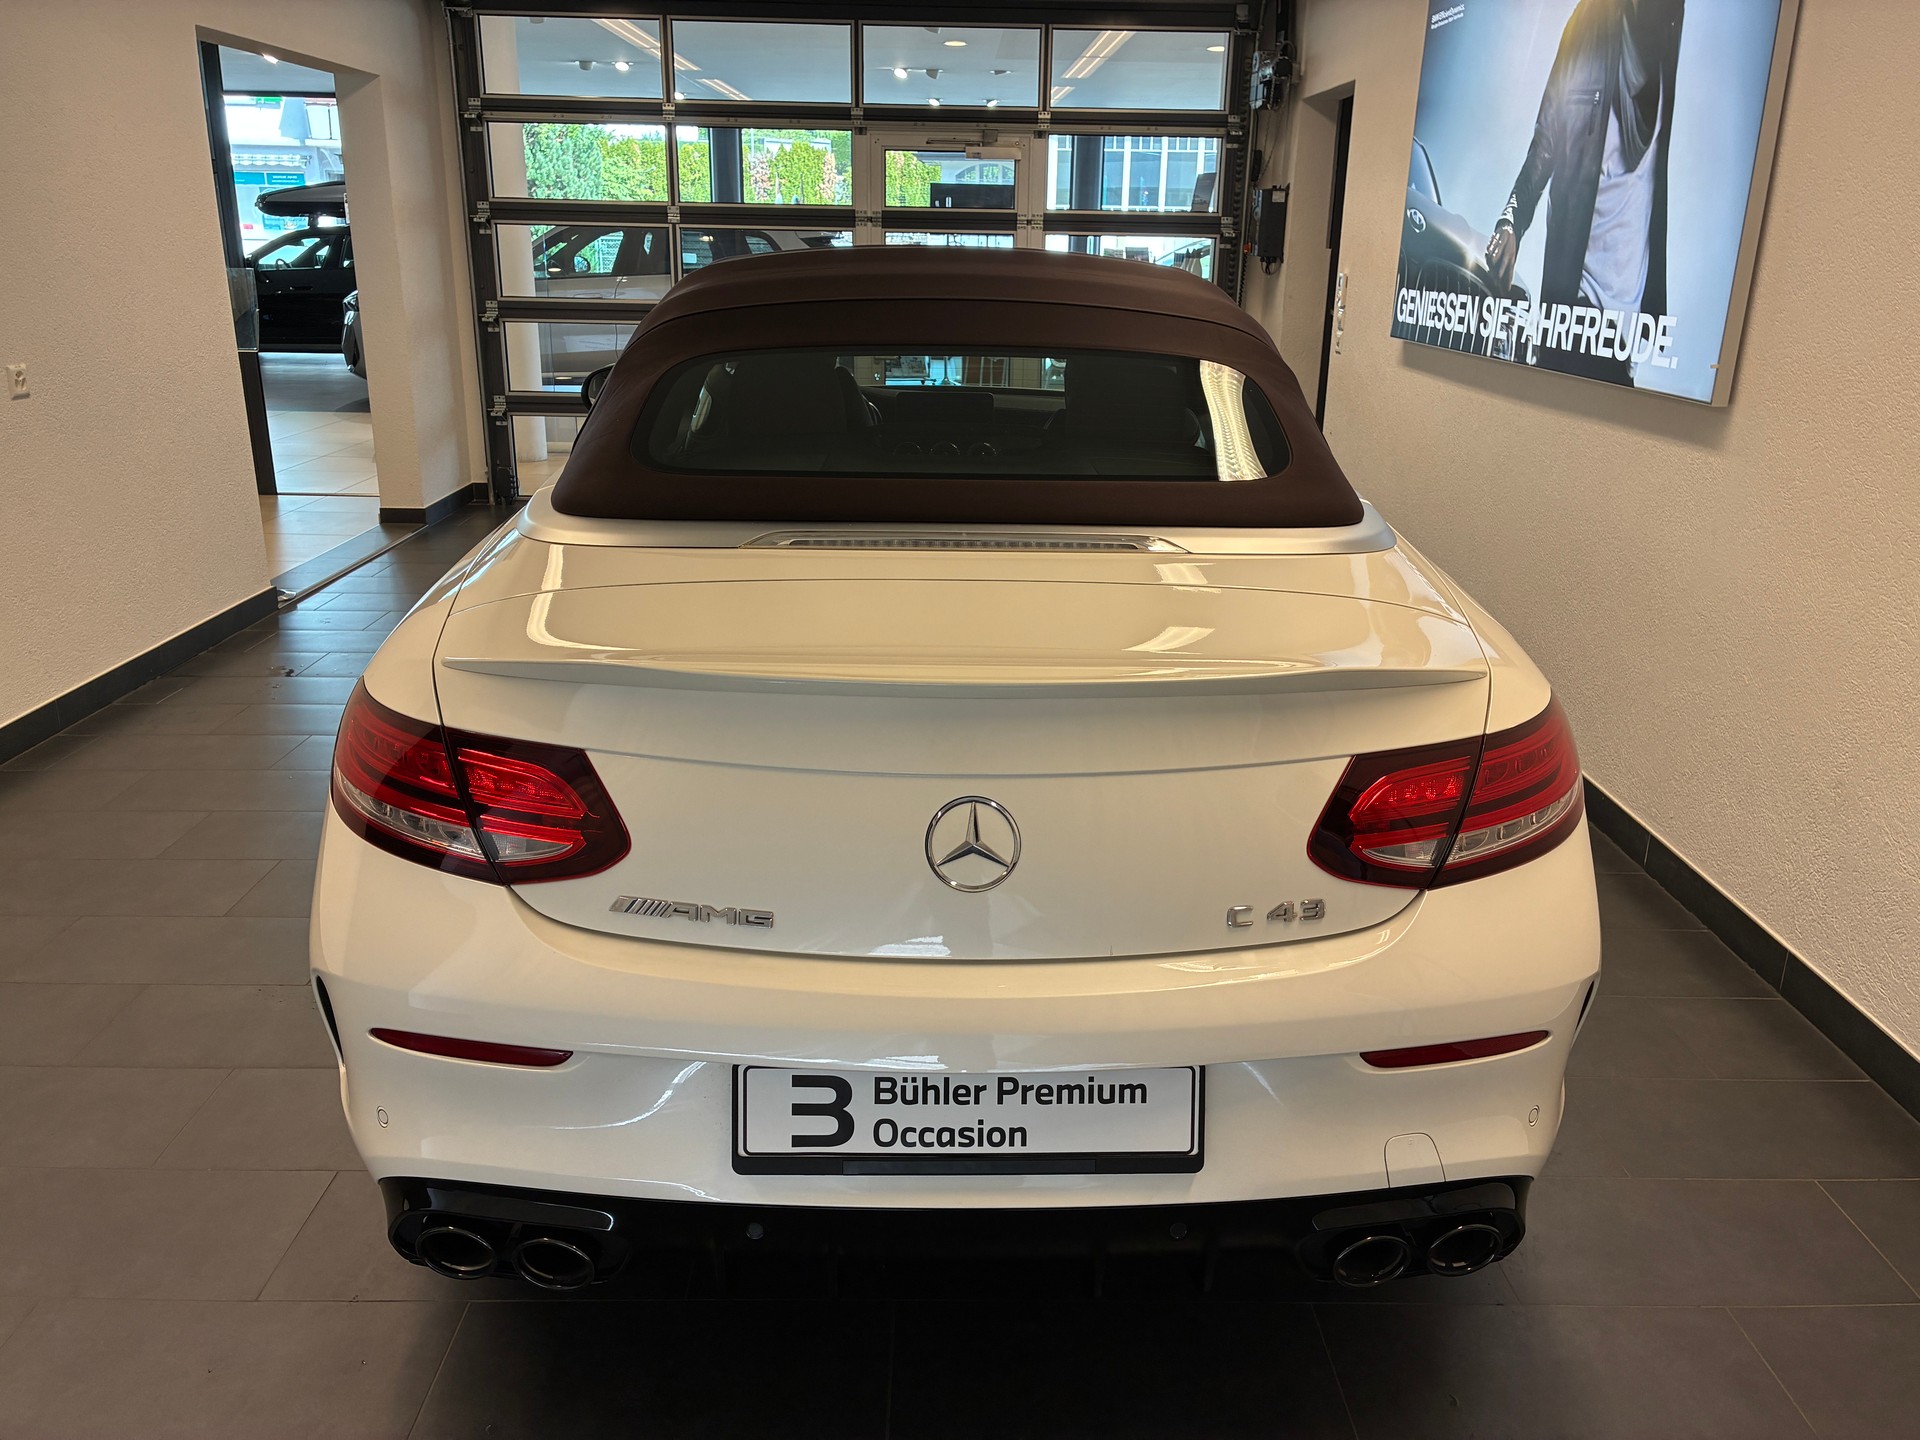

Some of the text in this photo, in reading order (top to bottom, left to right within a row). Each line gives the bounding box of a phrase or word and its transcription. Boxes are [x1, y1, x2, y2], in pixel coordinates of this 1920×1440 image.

[1397, 288, 1679, 369] GENIESSEN SIE FAHRFREUDE.
[660, 900, 774, 929] AMG
[1226, 899, 1326, 928] C 43
[874, 1075, 1148, 1106] Bühler Premium
[873, 1118, 1028, 1148] Occasion
